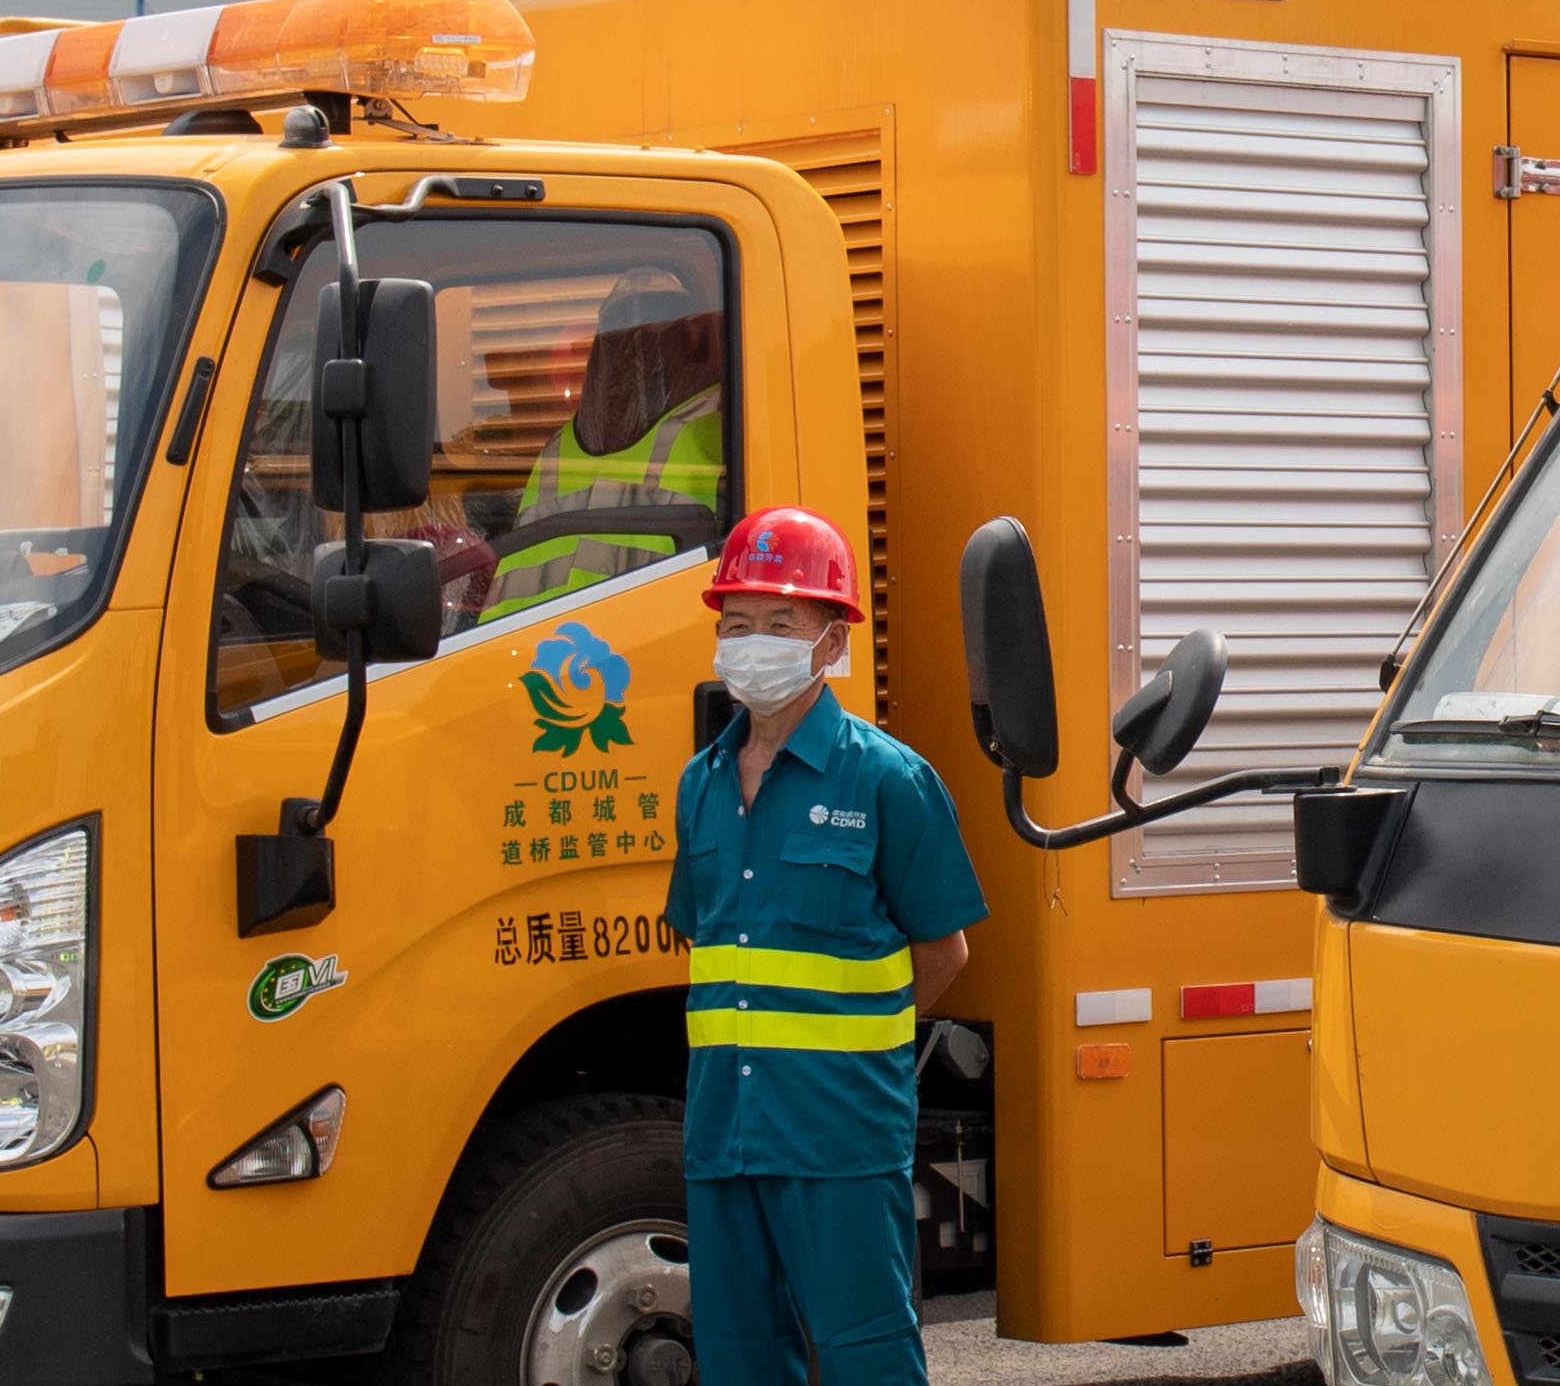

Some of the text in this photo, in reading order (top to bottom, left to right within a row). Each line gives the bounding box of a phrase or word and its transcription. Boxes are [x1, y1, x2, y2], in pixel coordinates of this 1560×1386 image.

[543, 769, 619, 794] CDUM
[503, 792, 660, 828] 成都城管
[501, 829, 666, 866] 道桥监管中心
